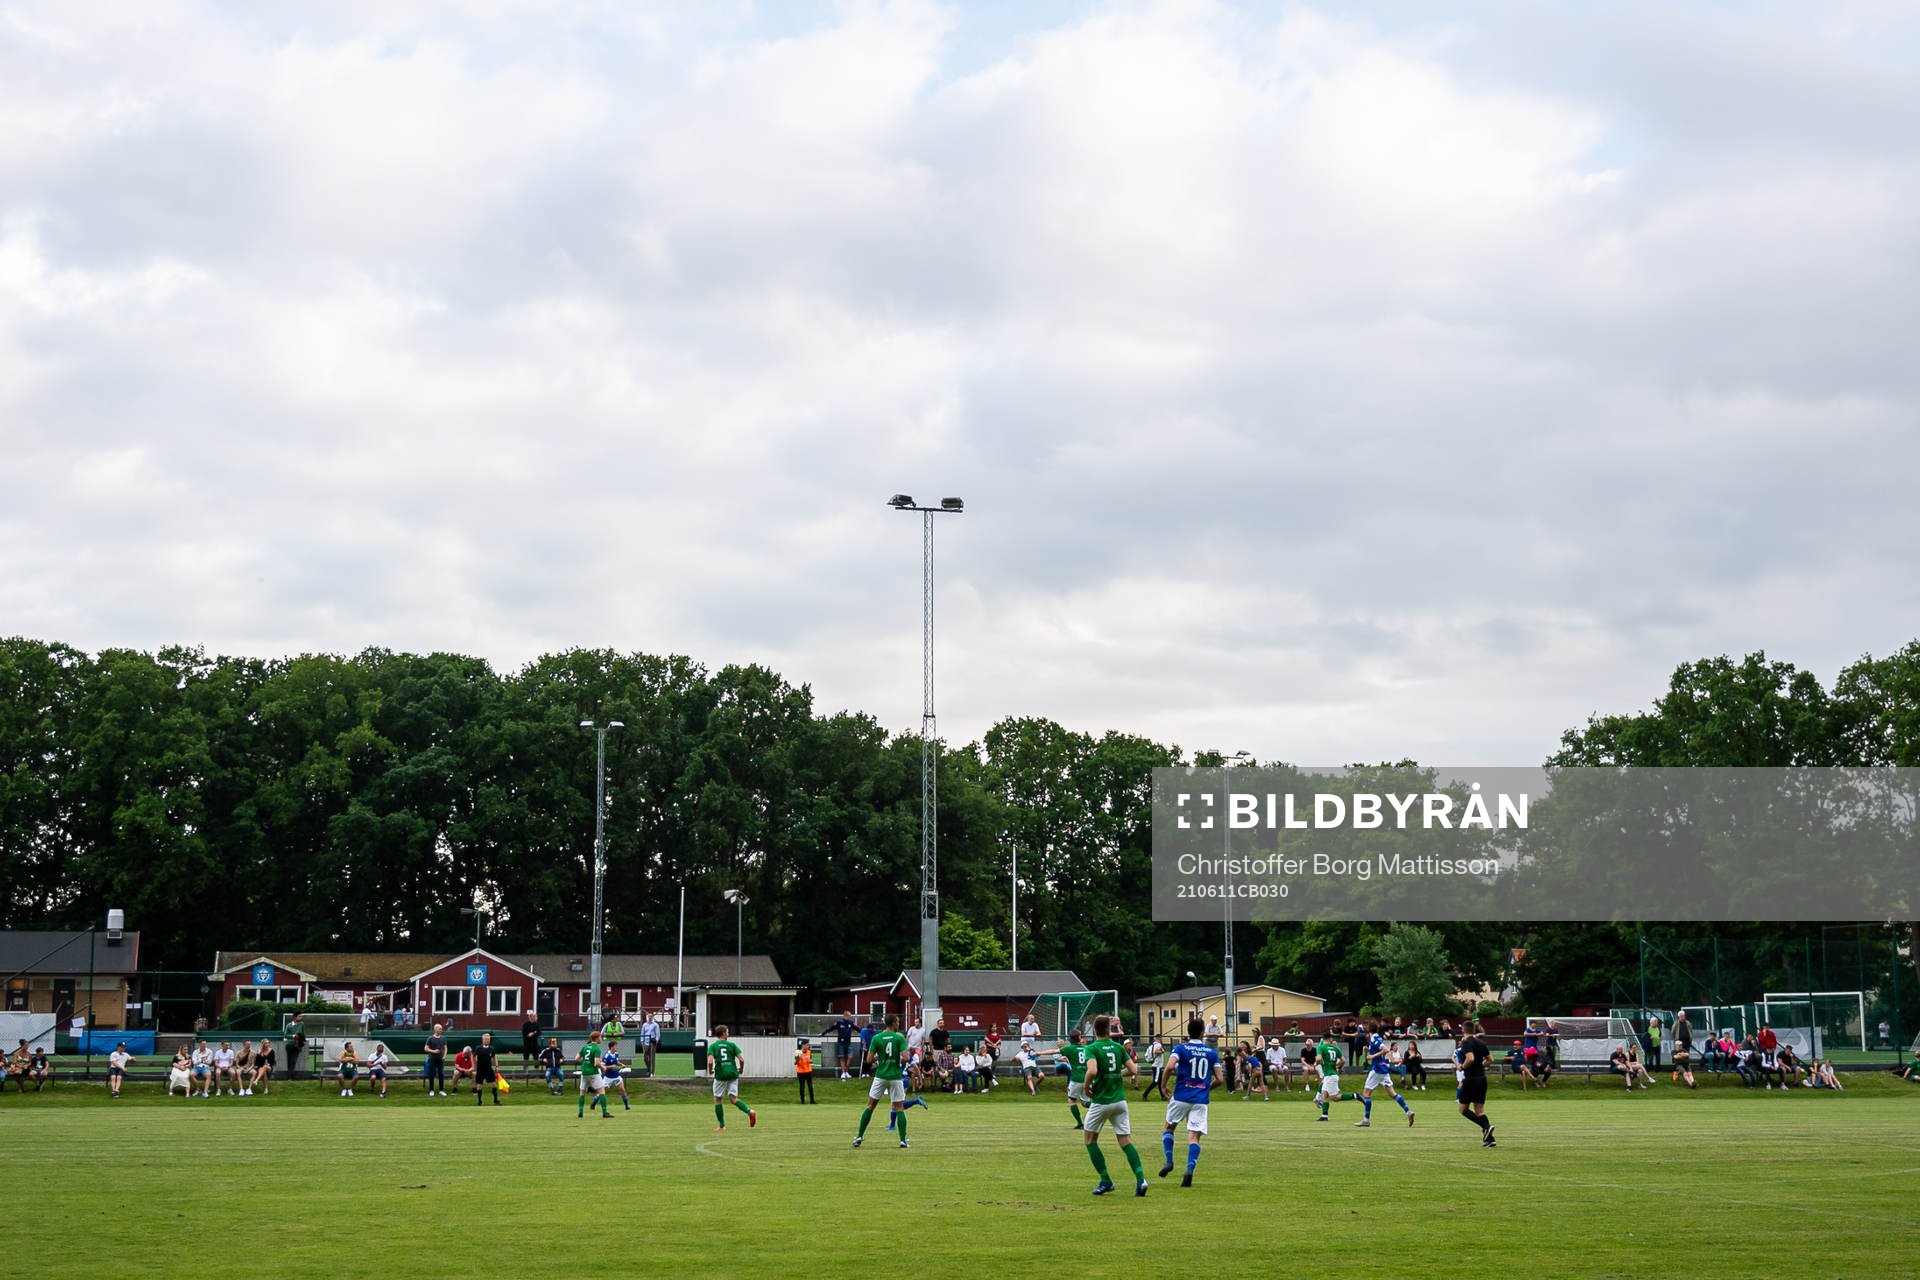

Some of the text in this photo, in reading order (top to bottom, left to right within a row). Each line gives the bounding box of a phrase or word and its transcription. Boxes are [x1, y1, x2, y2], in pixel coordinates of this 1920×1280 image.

[584, 1050, 591, 1060] 2
[720, 1048, 728, 1061] 5
[885, 1042, 893, 1057] 4
[1106, 1052, 1116, 1072] 3
[1189, 1057, 1209, 1080] 10
